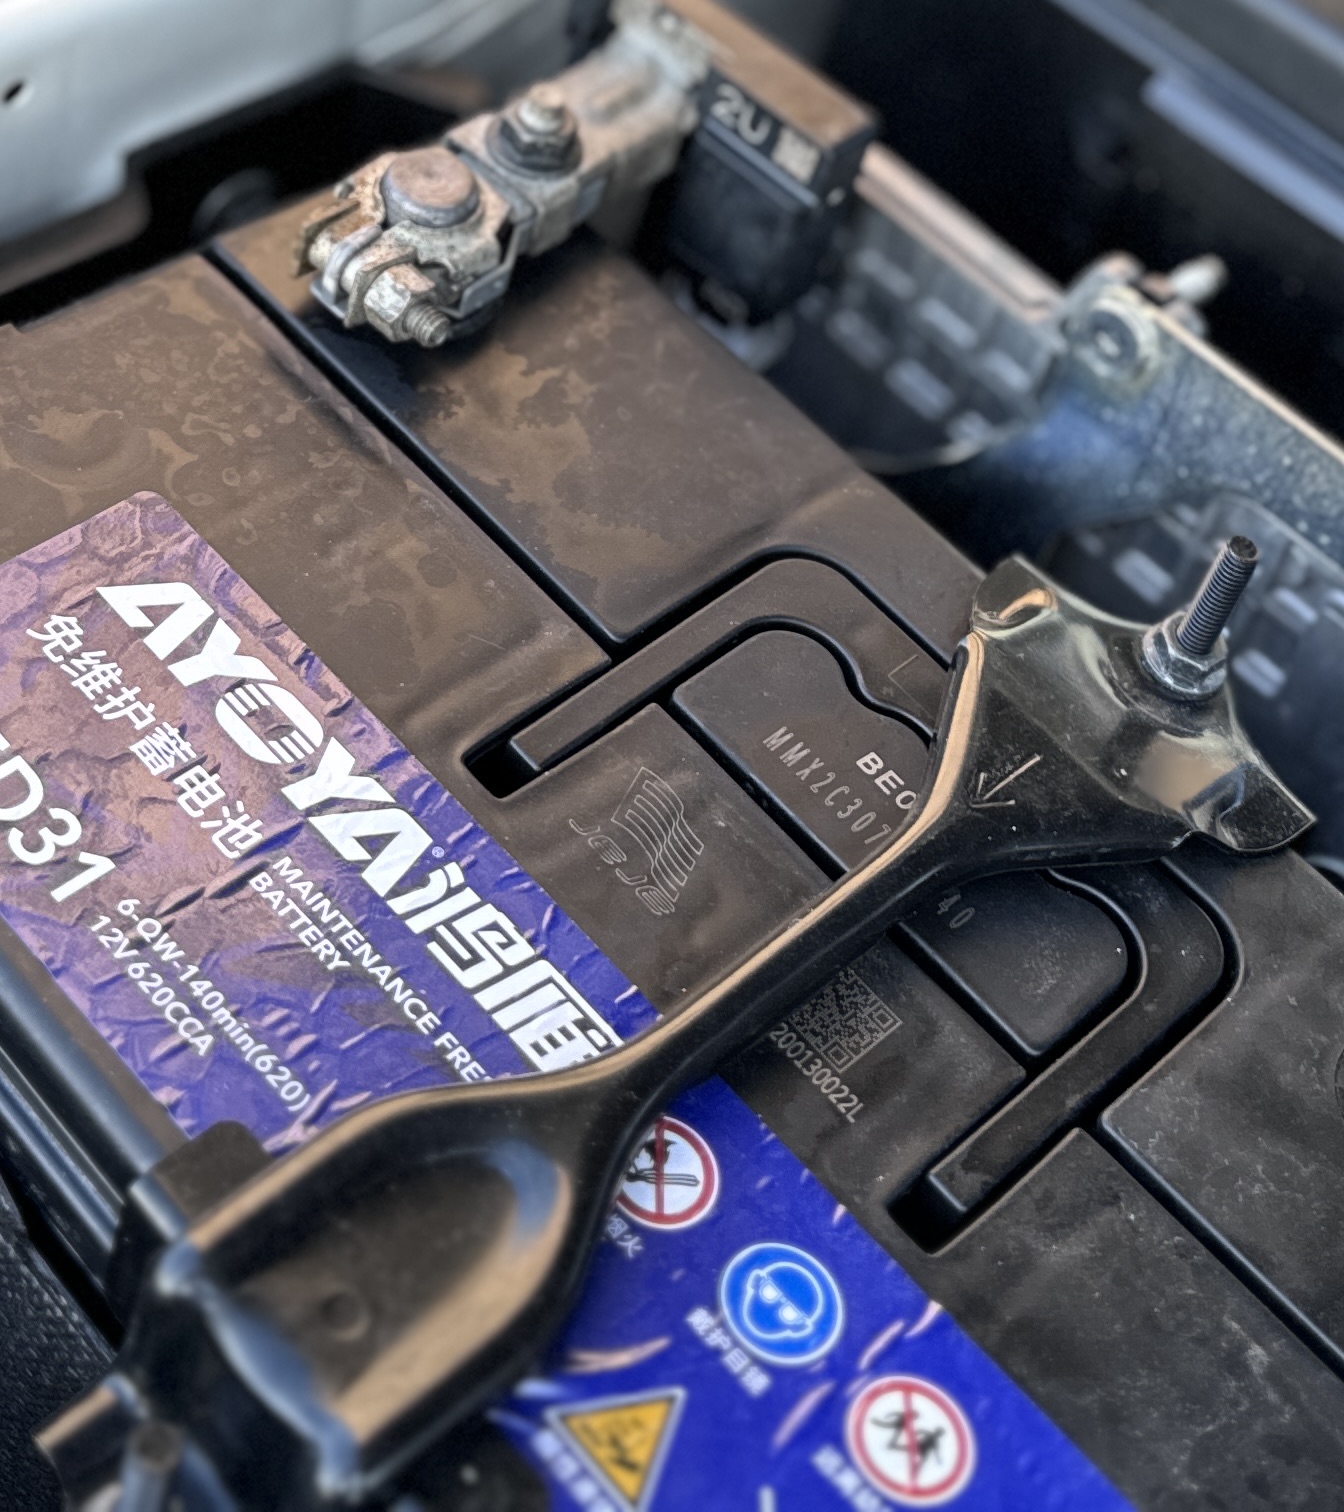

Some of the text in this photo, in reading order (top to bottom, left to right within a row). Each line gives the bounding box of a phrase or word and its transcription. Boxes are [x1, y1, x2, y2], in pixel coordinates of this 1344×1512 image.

[26, 613, 264, 859] 免维护蓄电池
[96, 581, 434, 897] AYOYA
[117, 898, 313, 1113] 6-QW-140min(620)
[249, 871, 352, 973] BATTERY
[272, 855, 440, 1037] MAINTENANCE
